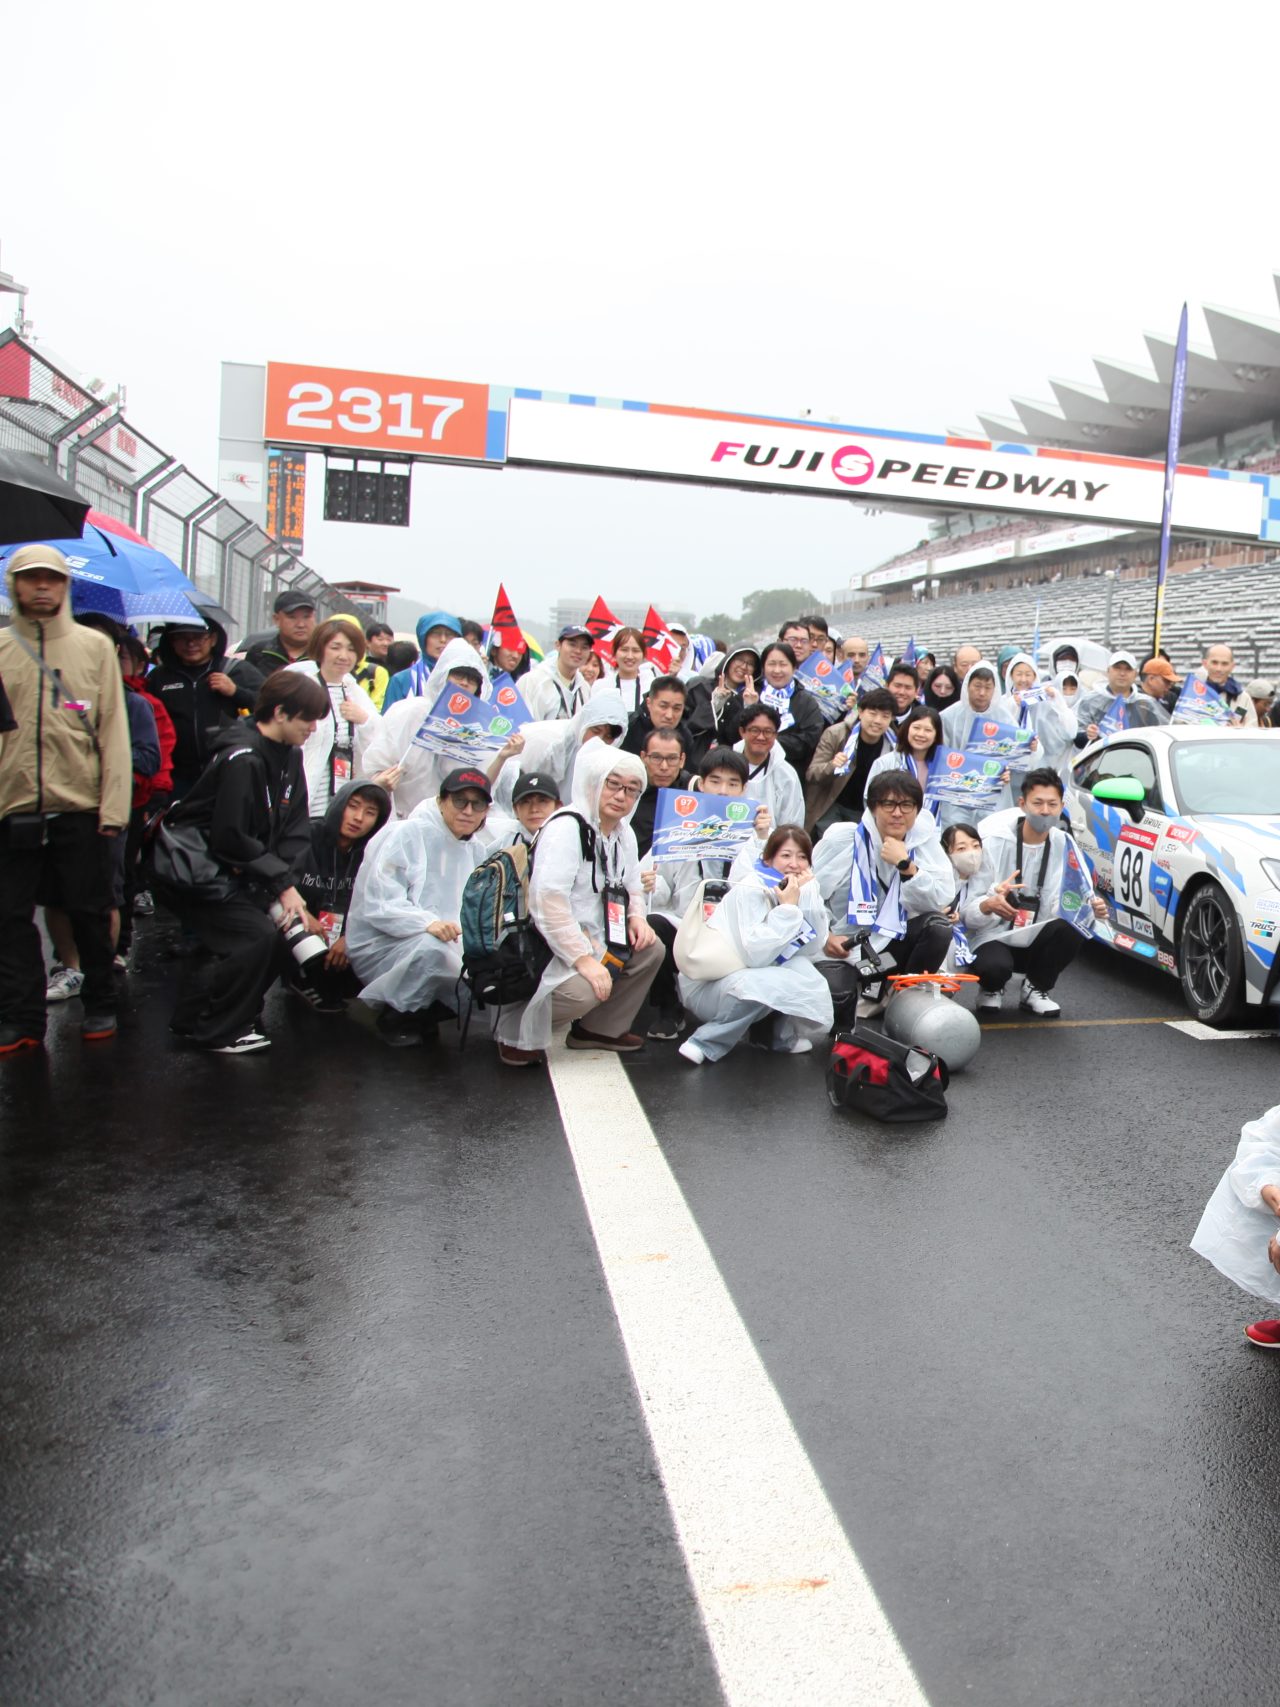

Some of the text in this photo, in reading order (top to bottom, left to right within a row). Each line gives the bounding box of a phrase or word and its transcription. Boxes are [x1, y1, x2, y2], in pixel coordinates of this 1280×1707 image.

[286, 381, 465, 441] 2317
[710, 441, 1110, 502] FUJI SPEEDWAY
[680, 798, 692, 806] 97
[1143, 817, 1162, 828] BRIDE
[1120, 846, 1144, 908] 98
[1249, 921, 1280, 932] TRUST
[1157, 950, 1175, 969] BBS
